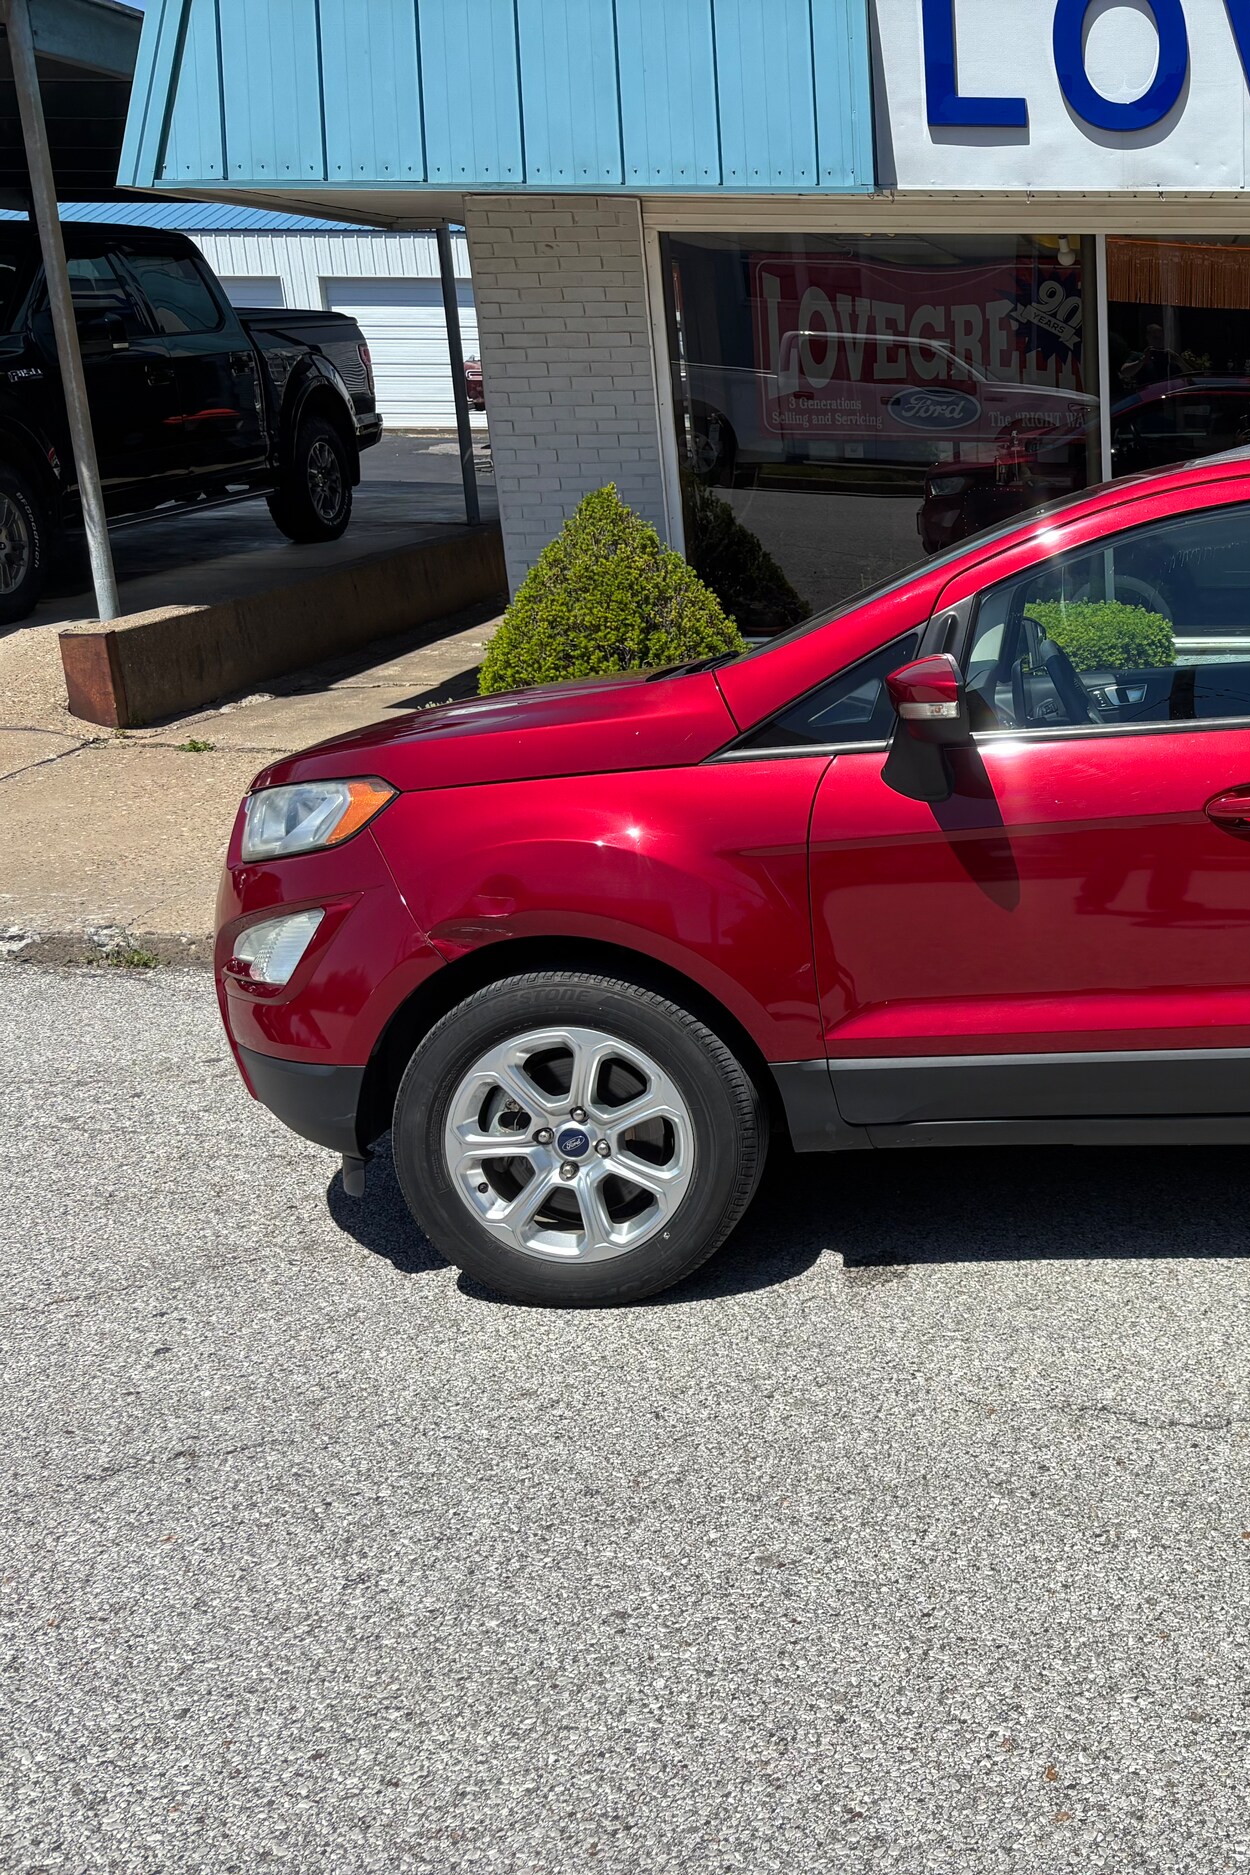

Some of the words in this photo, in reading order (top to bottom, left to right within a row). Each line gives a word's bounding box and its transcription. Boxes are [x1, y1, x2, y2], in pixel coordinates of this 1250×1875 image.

[1034, 280, 1083, 329] 90
[762, 271, 1085, 399] LOVEGRE
[1031, 311, 1066, 335] YEARS
[789, 397, 796, 409] 3
[800, 397, 862, 410] Generations
[901, 393, 964, 420] Ford
[772, 412, 810, 428] Selling
[812, 413, 833, 425] and
[835, 412, 883, 429] Servicing
[988, 411, 1012, 426] The
